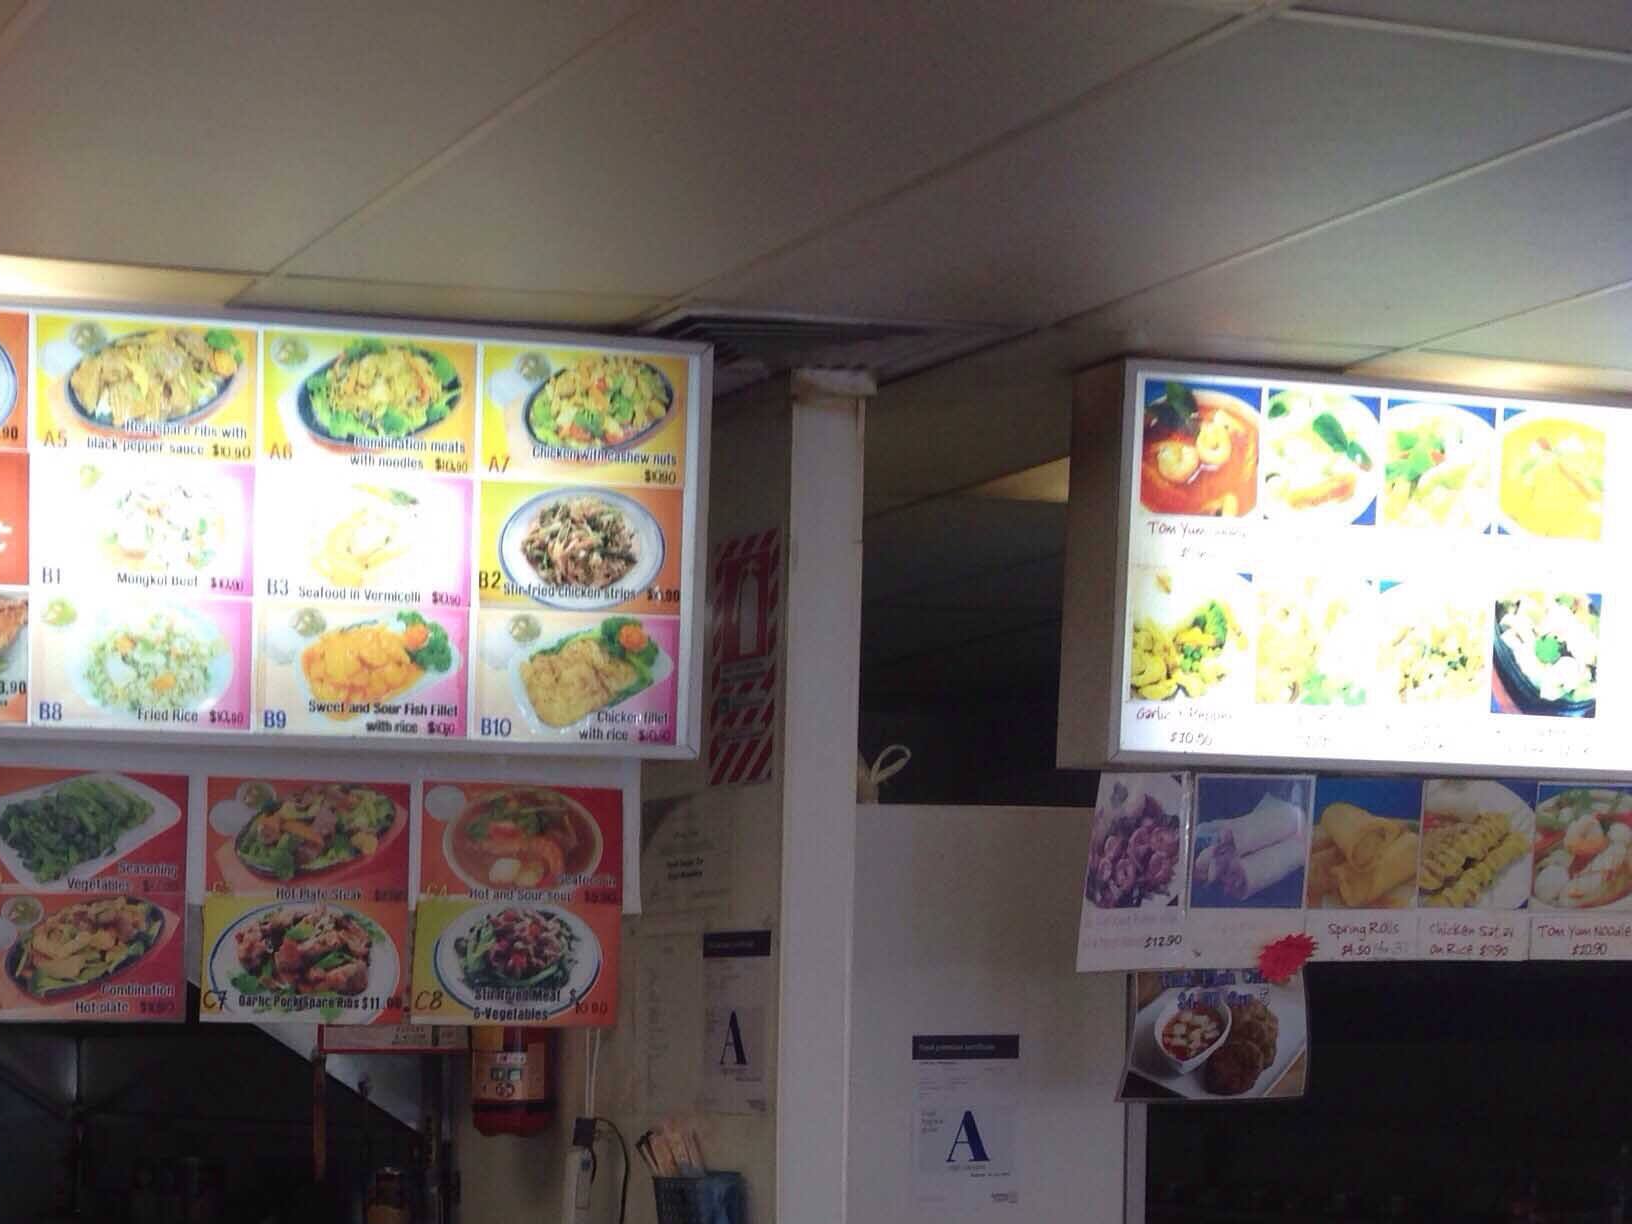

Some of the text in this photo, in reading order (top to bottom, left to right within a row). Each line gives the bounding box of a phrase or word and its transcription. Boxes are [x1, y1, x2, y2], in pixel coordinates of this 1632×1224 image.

[39, 702, 62, 720] B8
[264, 711, 286, 728] B9
[480, 717, 512, 736] B10
[720, 1010, 746, 1066] A
[946, 1110, 991, 1162] A
